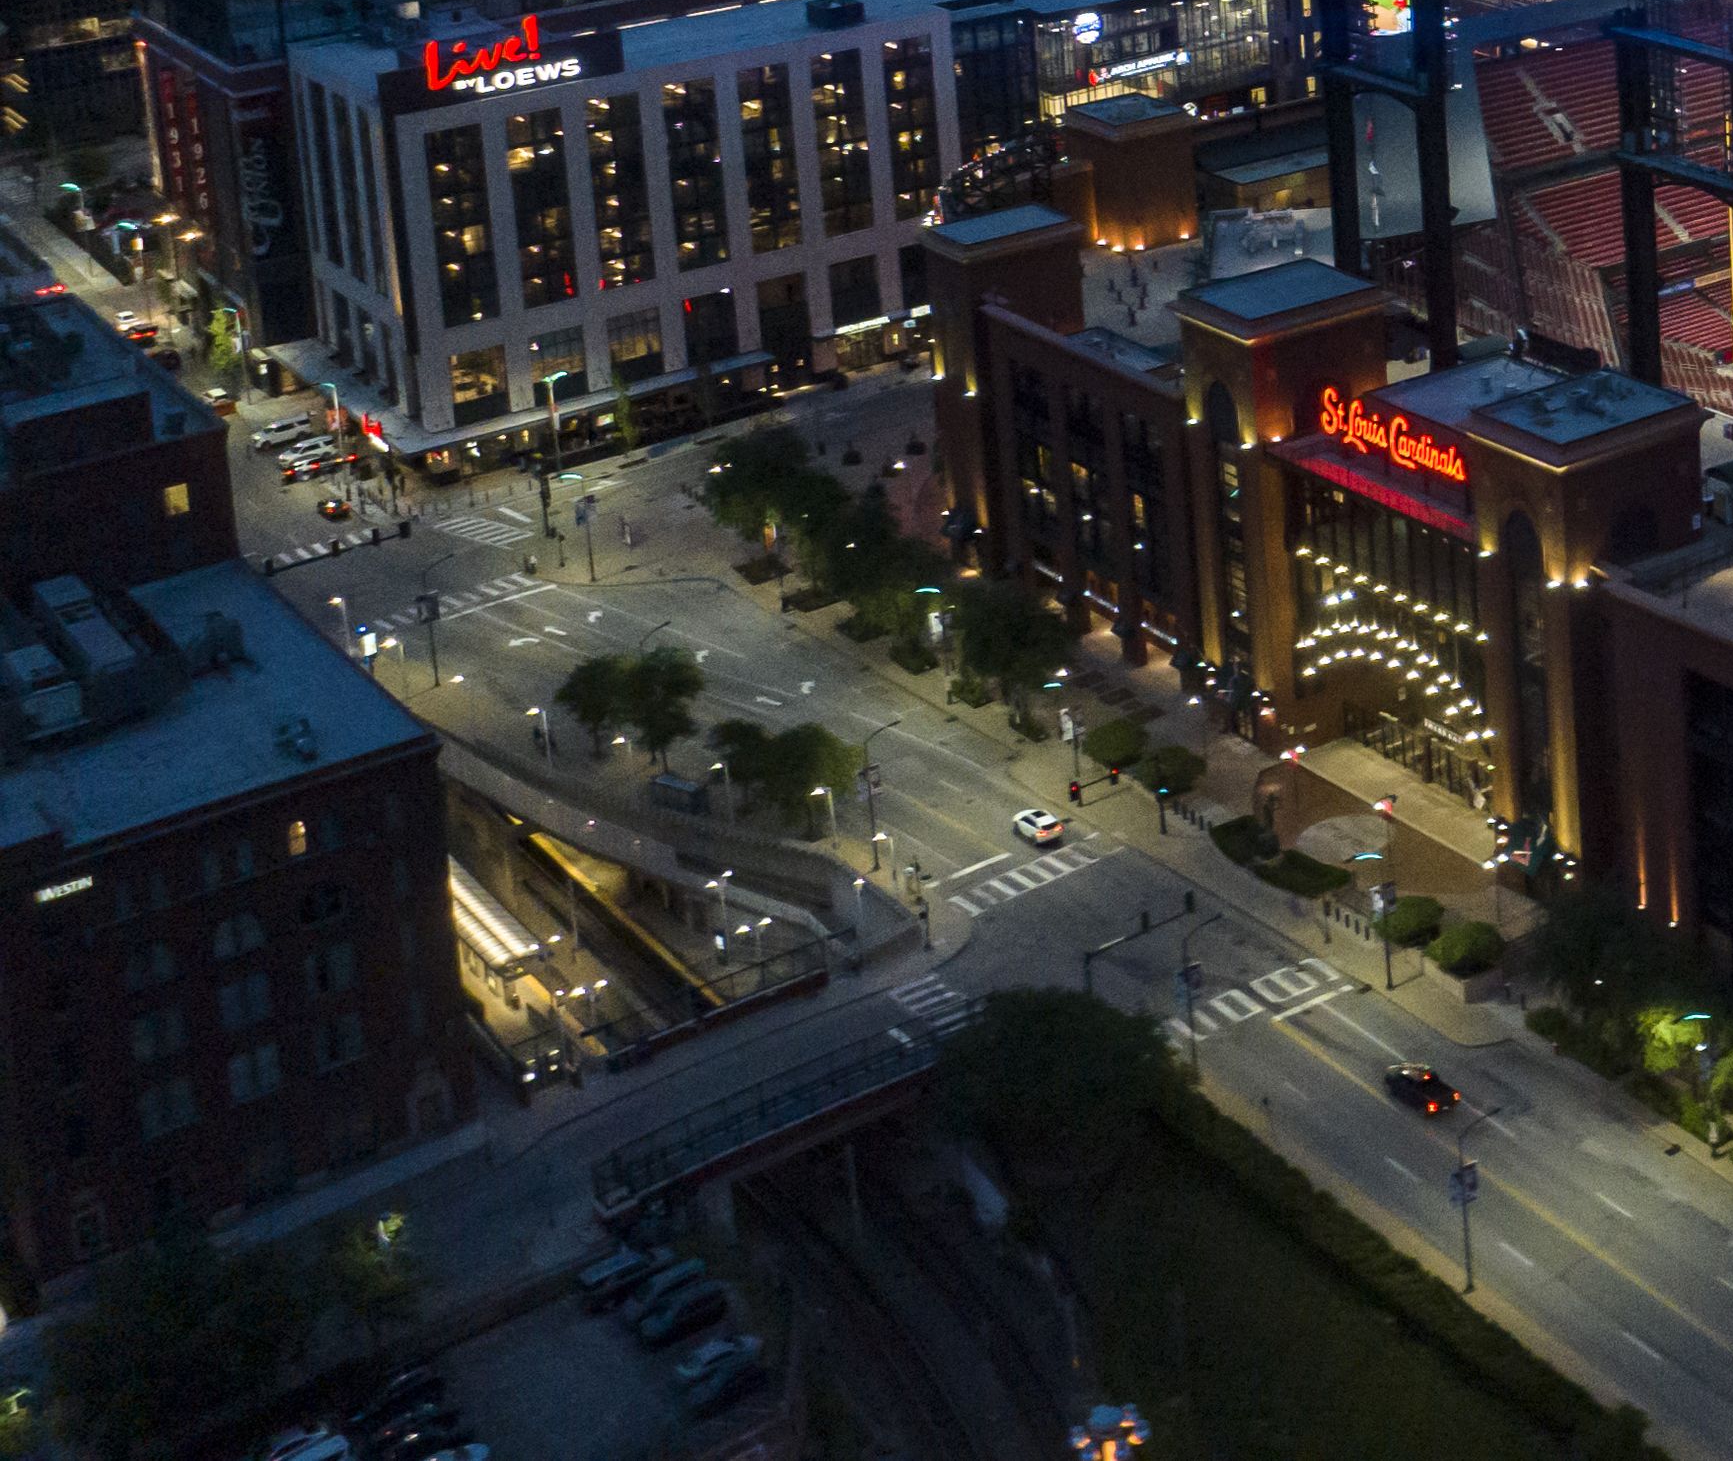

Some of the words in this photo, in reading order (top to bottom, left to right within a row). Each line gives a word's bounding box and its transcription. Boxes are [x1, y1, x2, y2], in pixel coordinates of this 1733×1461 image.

[424, 14, 541, 90] Live!
[475, 58, 582, 94] LOEWS
[165, 102, 184, 192] 1931
[1321, 386, 1348, 435] St.
[1343, 399, 1388, 454] Louis
[1389, 415, 1466, 481] Cardinals
